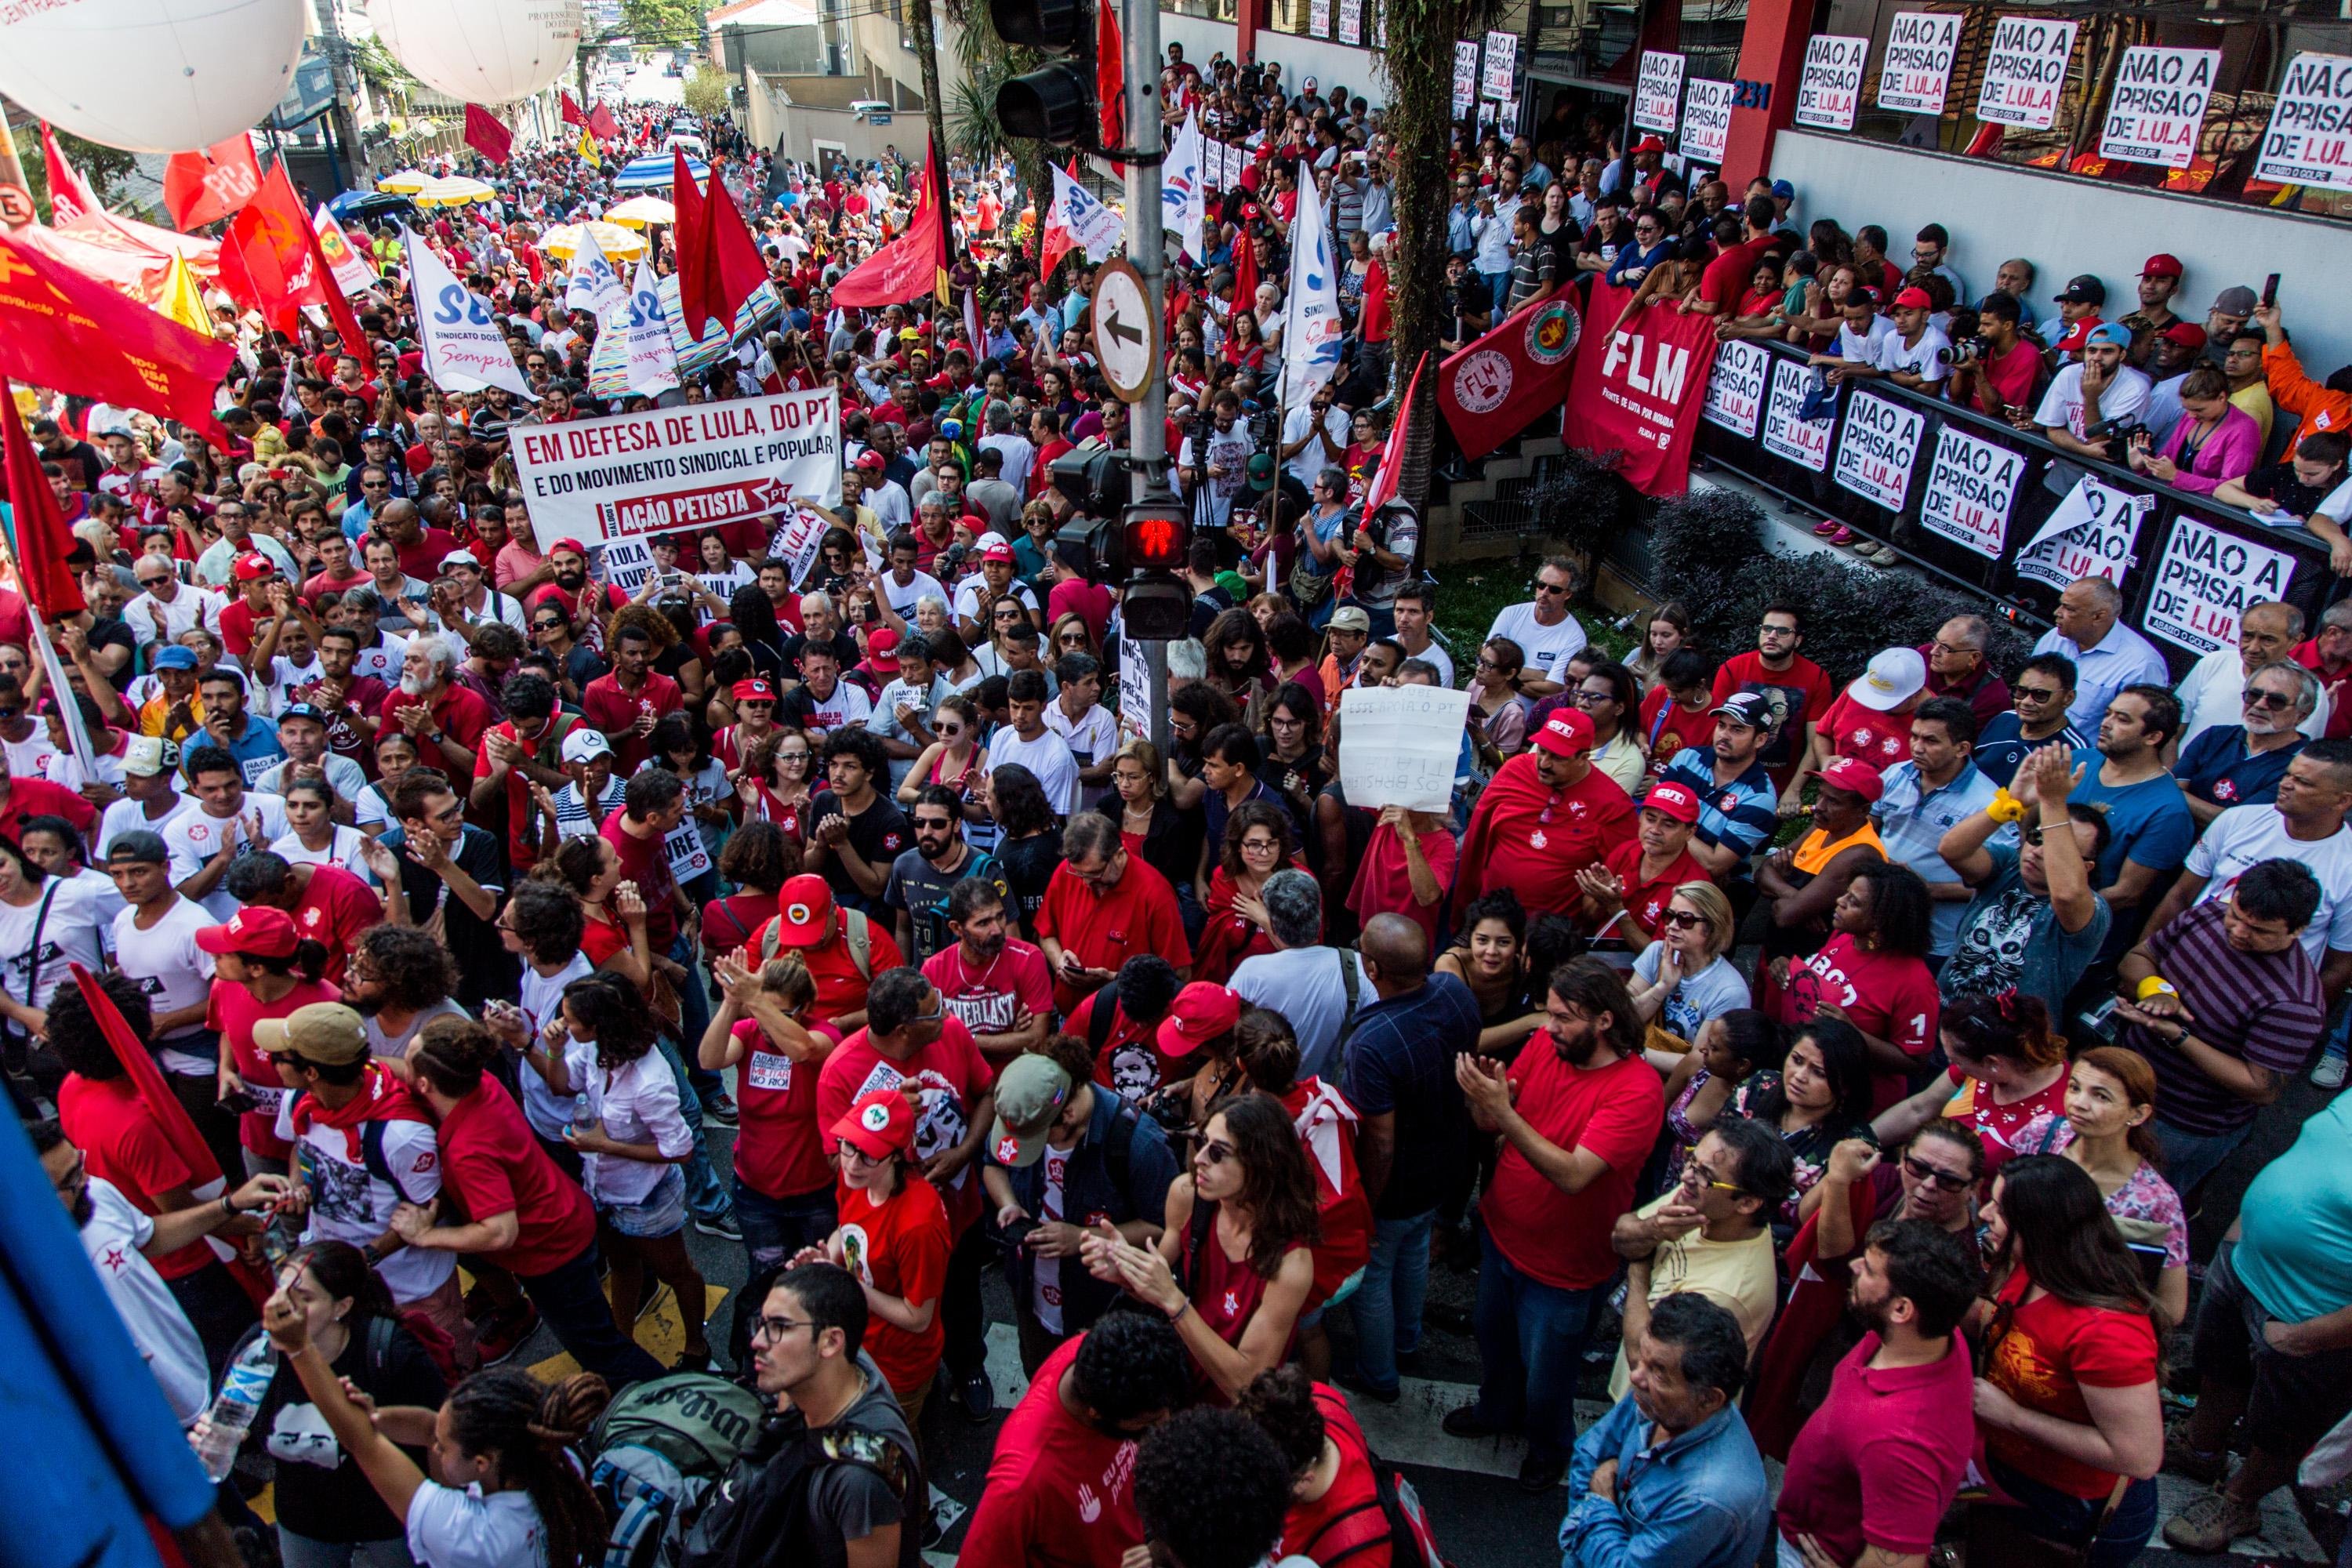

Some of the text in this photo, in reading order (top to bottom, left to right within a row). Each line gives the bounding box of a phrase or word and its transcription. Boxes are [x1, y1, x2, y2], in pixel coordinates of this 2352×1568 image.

[1317, 17, 1328, 27] LULA
[1341, 21, 1359, 34] DE LULA
[1893, 14, 1936, 45] NÃO
[1808, 37, 1846, 65] NÃO
[1994, 20, 2067, 56] NÃO À
[1887, 45, 1949, 72] PRISÃO
[1988, 53, 2061, 84] PRISÃO
[2122, 49, 2209, 87] NÃO À
[1485, 71, 1510, 88] DE LULA
[1804, 66, 1857, 91] PRISÃO
[1883, 72, 1942, 96] DE LULA
[1637, 97, 1674, 118] DE LULA
[1732, 79, 1772, 111] 231
[1800, 90, 1852, 114] DE LULA
[1982, 82, 2052, 111] DE LULA
[2114, 85, 2201, 117] PRISÃO
[1682, 127, 1723, 149] DE LULA
[2107, 116, 2191, 147] DE LULA
[2265, 133, 2352, 166] DE LUL
[2264, 165, 2291, 176] ABAIXO
[2300, 169, 2327, 180] GOLPE
[435, 331, 478, 340] SINDICATO
[1464, 361, 1499, 396] FLM
[1602, 329, 1690, 405] FLM
[1711, 366, 1759, 400] PRISÃO
[1602, 387, 1619, 405] FRENTE
[1621, 397, 1628, 408] DE
[1628, 401, 1641, 415] LUTA
[1642, 407, 1652, 420] POR
[1705, 385, 1755, 423] DE LULA
[524, 395, 831, 465] EM DEFESA DE LULA, DO PT
[1768, 416, 1824, 455] DE LULA
[1850, 394, 1916, 446] NÃO À
[1845, 423, 1911, 470] PRISÃO
[1939, 434, 2015, 488] NÃO À
[535, 434, 833, 497] E DO MOVIMENTO SINDICAL E POPULAR
[1839, 448, 1902, 494] DE LULA
[771, 486, 787, 501] PT
[1838, 470, 1857, 485] ABAIXO
[1861, 481, 1878, 496] GOLPE
[1933, 463, 2007, 514] PRISÃO
[622, 498, 671, 534] AÇÃO
[674, 488, 749, 521] PETISTA
[1926, 489, 2001, 540] DE LULA
[2111, 496, 2132, 535] À
[780, 514, 816, 561] LULA
[1926, 515, 1947, 532] ABAIXO
[1952, 526, 1973, 542] GOLPE
[608, 544, 648, 568] LULA
[2020, 564, 2049, 579] ABAIXO
[2172, 524, 2280, 594] NÃO À
[2153, 588, 2239, 646] DE LUL
[2153, 619, 2180, 638] ABAIXO
[2189, 634, 2216, 652] GOLPE
[1350, 702, 1374, 713] ESSE
[1421, 702, 1431, 712] O
[1438, 702, 1457, 713] PT
[1548, 719, 1574, 739] CUT
[1655, 788, 1686, 805] CUT
[1910, 1014, 1926, 1036] 1
[752, 1068, 789, 1079] MILITAR
[1004, 1145, 1012, 1155] 13
[634, 1388, 750, 1449] Wilson
